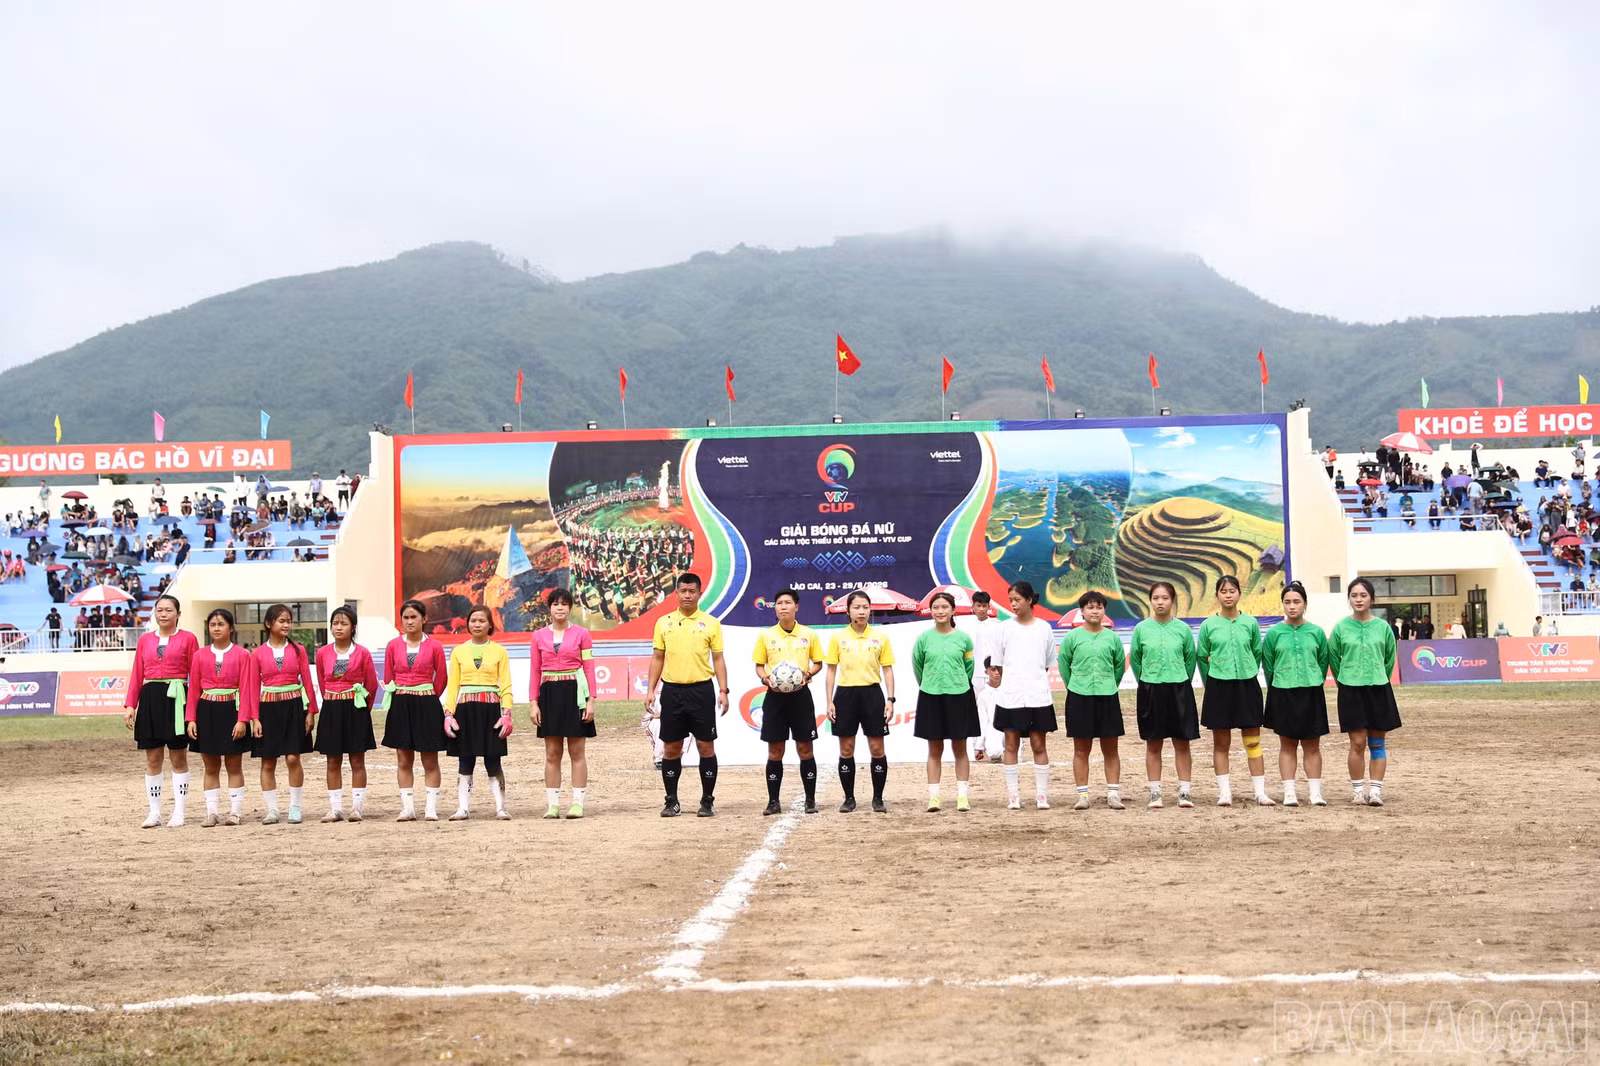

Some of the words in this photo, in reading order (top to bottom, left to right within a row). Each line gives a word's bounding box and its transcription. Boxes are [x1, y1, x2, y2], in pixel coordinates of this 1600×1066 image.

[1414, 411, 1483, 435] KHOẺ
[1493, 408, 1528, 433] ĐỂ
[1539, 413, 1592, 434] HỌC
[95, 448, 144, 470] BÁC
[155, 445, 189, 468] HỒ
[198, 446, 223, 467] VĨ
[232, 448, 274, 469] ĐẠI
[929, 450, 961, 458] viettel
[717, 456, 748, 464] viettel
[824, 491, 848, 502] VTV
[818, 502, 855, 513] CUP
[781, 523, 806, 537] GIẢI
[811, 522, 848, 536] BÓNG
[851, 522, 871, 535] ĐÁ
[874, 521, 895, 535] NỮ
[861, 536, 878, 544] NAM
[790, 582, 805, 590] LÀO
[825, 582, 836, 590] 23
[1528, 643, 1569, 656] VTV5
[1435, 656, 1462, 668] VTV
[88, 677, 127, 690] VTV5
